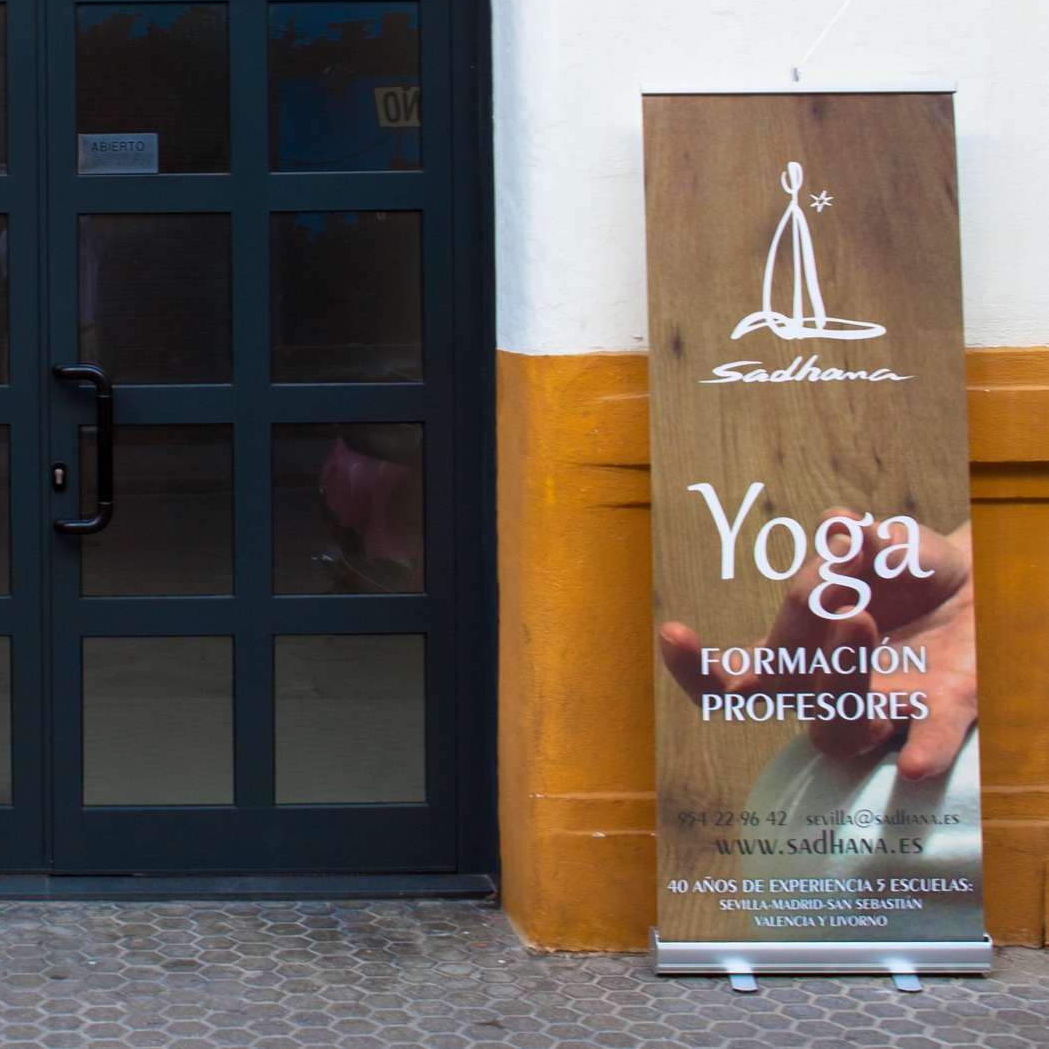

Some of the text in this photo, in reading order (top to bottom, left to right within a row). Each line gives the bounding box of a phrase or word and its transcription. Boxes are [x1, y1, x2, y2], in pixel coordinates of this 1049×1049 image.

[91, 140, 146, 152] ABIERTO
[698, 354, 916, 384] Sadhana
[687, 481, 936, 620] Yoga
[700, 636, 927, 675] FORMACIÓN
[701, 690, 930, 722] PROFESORES
[678, 810, 708, 827] 954
[714, 810, 735, 827] 22
[739, 810, 761, 827] 96
[766, 810, 789, 827] 42
[667, 878, 690, 894] 40
[692, 875, 738, 894] AÑOS
[742, 878, 765, 893] DE
[769, 877, 874, 893] EXPERIENCIA
[889, 877, 974, 892] ESCUELAS:
[719, 895, 923, 911] SEVILLA-MADRID-SAN SEBASTIÁN
[754, 914, 889, 928] VALENCIA Y LIVORNO
